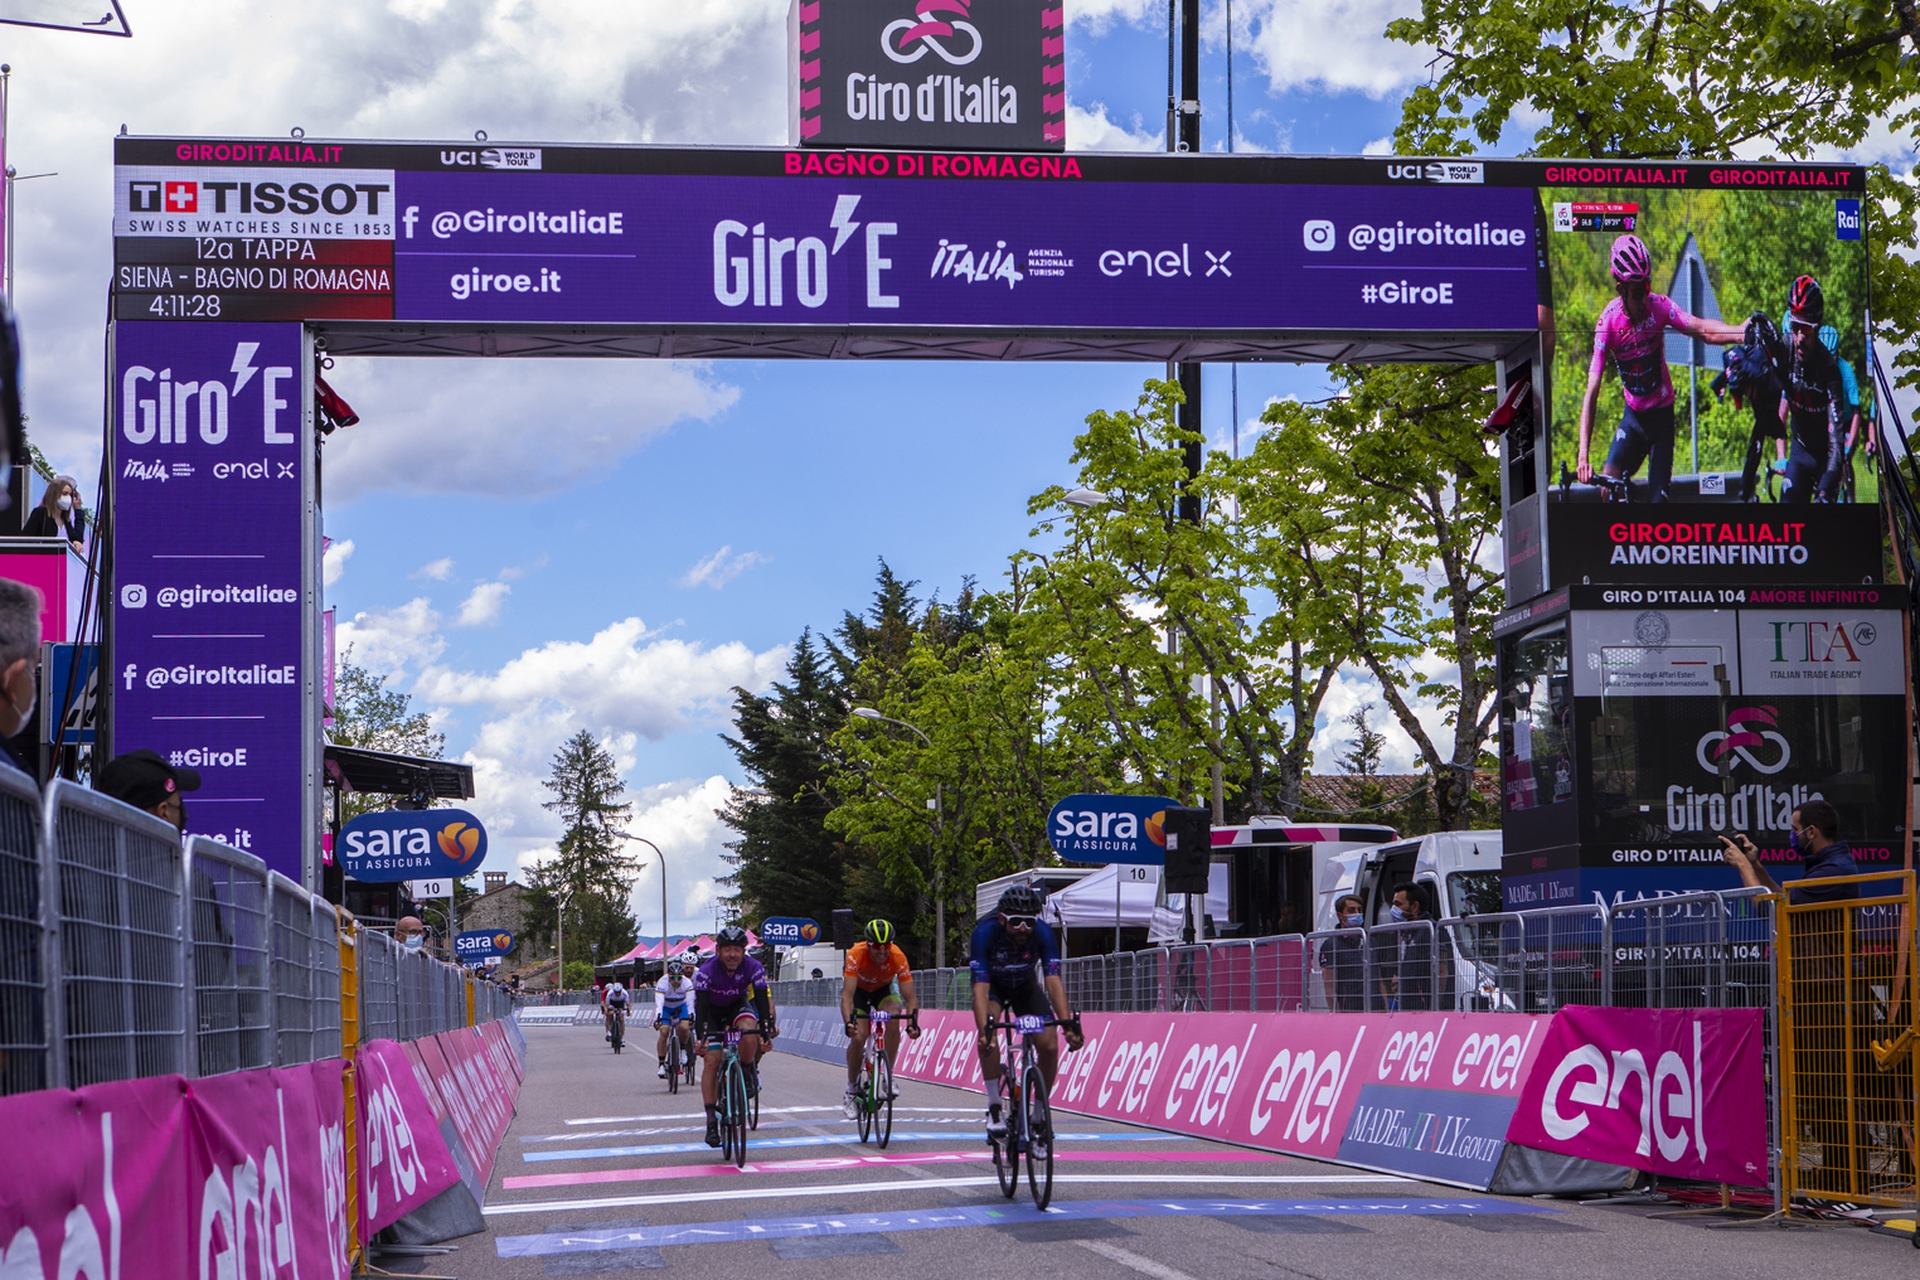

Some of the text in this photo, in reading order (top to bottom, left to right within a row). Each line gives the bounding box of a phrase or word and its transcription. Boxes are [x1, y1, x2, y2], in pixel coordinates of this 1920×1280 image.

[847, 72, 1018, 124] Giro d'Italia
[176, 143, 343, 162] GIRODITALIA.IT
[440, 150, 478, 167] UCI
[504, 152, 537, 161] WORLD
[506, 160, 530, 168] TOUR
[784, 153, 1083, 178] BAGNO DI ROMAGNA
[1387, 164, 1422, 181] UCI
[1448, 165, 1480, 174] WORLD
[1450, 173, 1473, 181] TOUR
[1545, 168, 1688, 184] GIRODITALIA.IT
[1709, 169, 1851, 186] GIRODITALIA.IT
[203, 182, 390, 215] TISSOT
[129, 220, 391, 235] SWISS WATCHES SINCE 1853
[431, 208, 624, 239] @GiroItaliaE
[1838, 209, 1859, 229] Rai
[1347, 221, 1527, 254] @giroitaliae
[196, 238, 316, 260] 12a TAPPA
[1028, 249, 1064, 257] AGENZIA
[714, 219, 829, 308] Giro
[1028, 258, 1075, 267] NAZIONALE
[1099, 243, 1192, 278] enel
[121, 266, 174, 288] SIENA
[195, 267, 264, 289] BAGNO
[269, 268, 287, 289] DI
[293, 268, 391, 290] ROMAGNA
[1028, 268, 1066, 277] TURISMO
[451, 266, 562, 301] giroe.it
[1362, 282, 1454, 306] #GiroE
[149, 295, 222, 317] 4:11:28
[123, 366, 229, 445] Giro
[213, 458, 270, 479] enel
[1609, 522, 1806, 544] GIRODITALIA.IT
[1610, 544, 1809, 565] AMOREINFINITO
[156, 584, 298, 608] @giroitaliae
[1602, 590, 1880, 604] GIRO D'ITALIA 104 AMORE INFINITO
[1769, 621, 1862, 662] ITA
[146, 665, 296, 689] @GiroItaliaE
[1677, 671, 1696, 679] Esteri
[1770, 670, 1862, 680] ITALIAN TRADE AGENCY
[170, 747, 247, 768] #GiroE
[1666, 784, 1726, 831] Giro
[1055, 809, 1138, 839] sara
[346, 827, 430, 858] sara
[1055, 839, 1137, 852] TI ASSICURA
[347, 858, 431, 870] TI ASSICURA
[1612, 850, 1653, 863] GIRO
[1657, 849, 1725, 862] D'ITALIA
[1130, 868, 1146, 880] 10
[423, 881, 441, 896] 10
[764, 923, 798, 936] sara
[457, 936, 491, 950] sara
[1733, 945, 1761, 959] 104
[1019, 1015, 1041, 1030] 1601
[1377, 1017, 1448, 1083] enel
[1452, 1020, 1538, 1090] enel
[1097, 1021, 1175, 1114] enel
[1165, 1023, 1257, 1127] enel
[1250, 1025, 1367, 1144] enel
[1541, 1020, 1708, 1164] enel
[366, 1052, 428, 1220] enel
